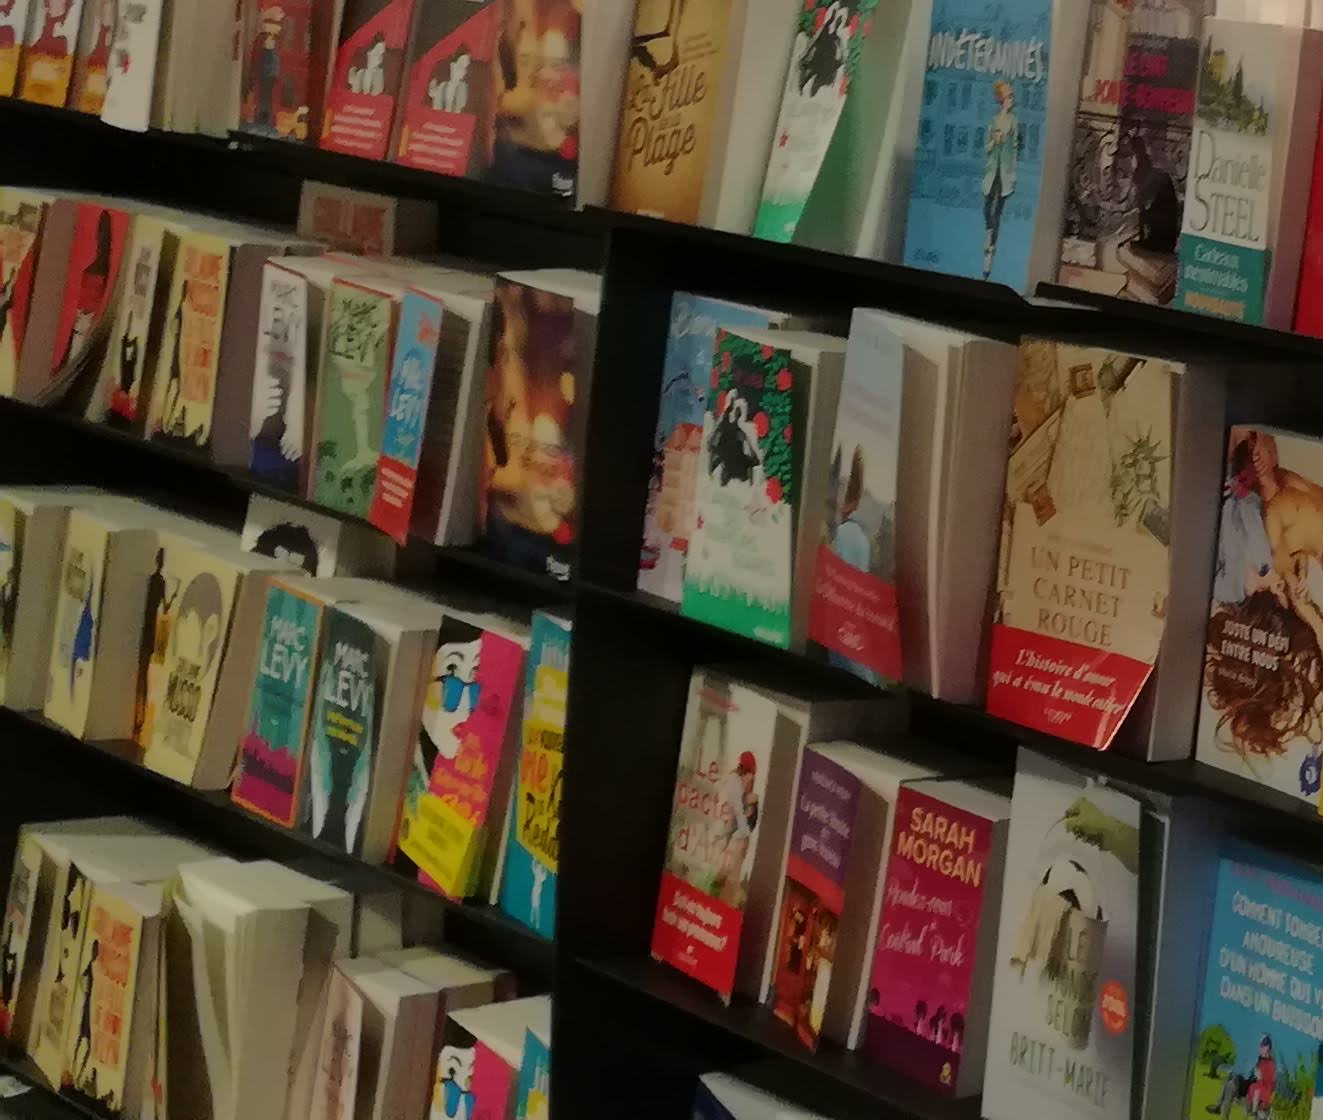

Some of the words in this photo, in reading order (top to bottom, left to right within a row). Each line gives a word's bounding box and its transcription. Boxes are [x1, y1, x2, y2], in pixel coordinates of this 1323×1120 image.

[627, 116, 697, 177] Plage
[1190, 180, 1260, 243] STEEL
[1068, 555, 1131, 590] PETIT
[1033, 576, 1120, 618] CARNET
[1038, 607, 1113, 647] ROUGE
[259, 646, 311, 691] LEVY
[322, 670, 374, 719] LEVY
[909, 806, 977, 854] SARAH
[896, 830, 984, 889] MORGAN
